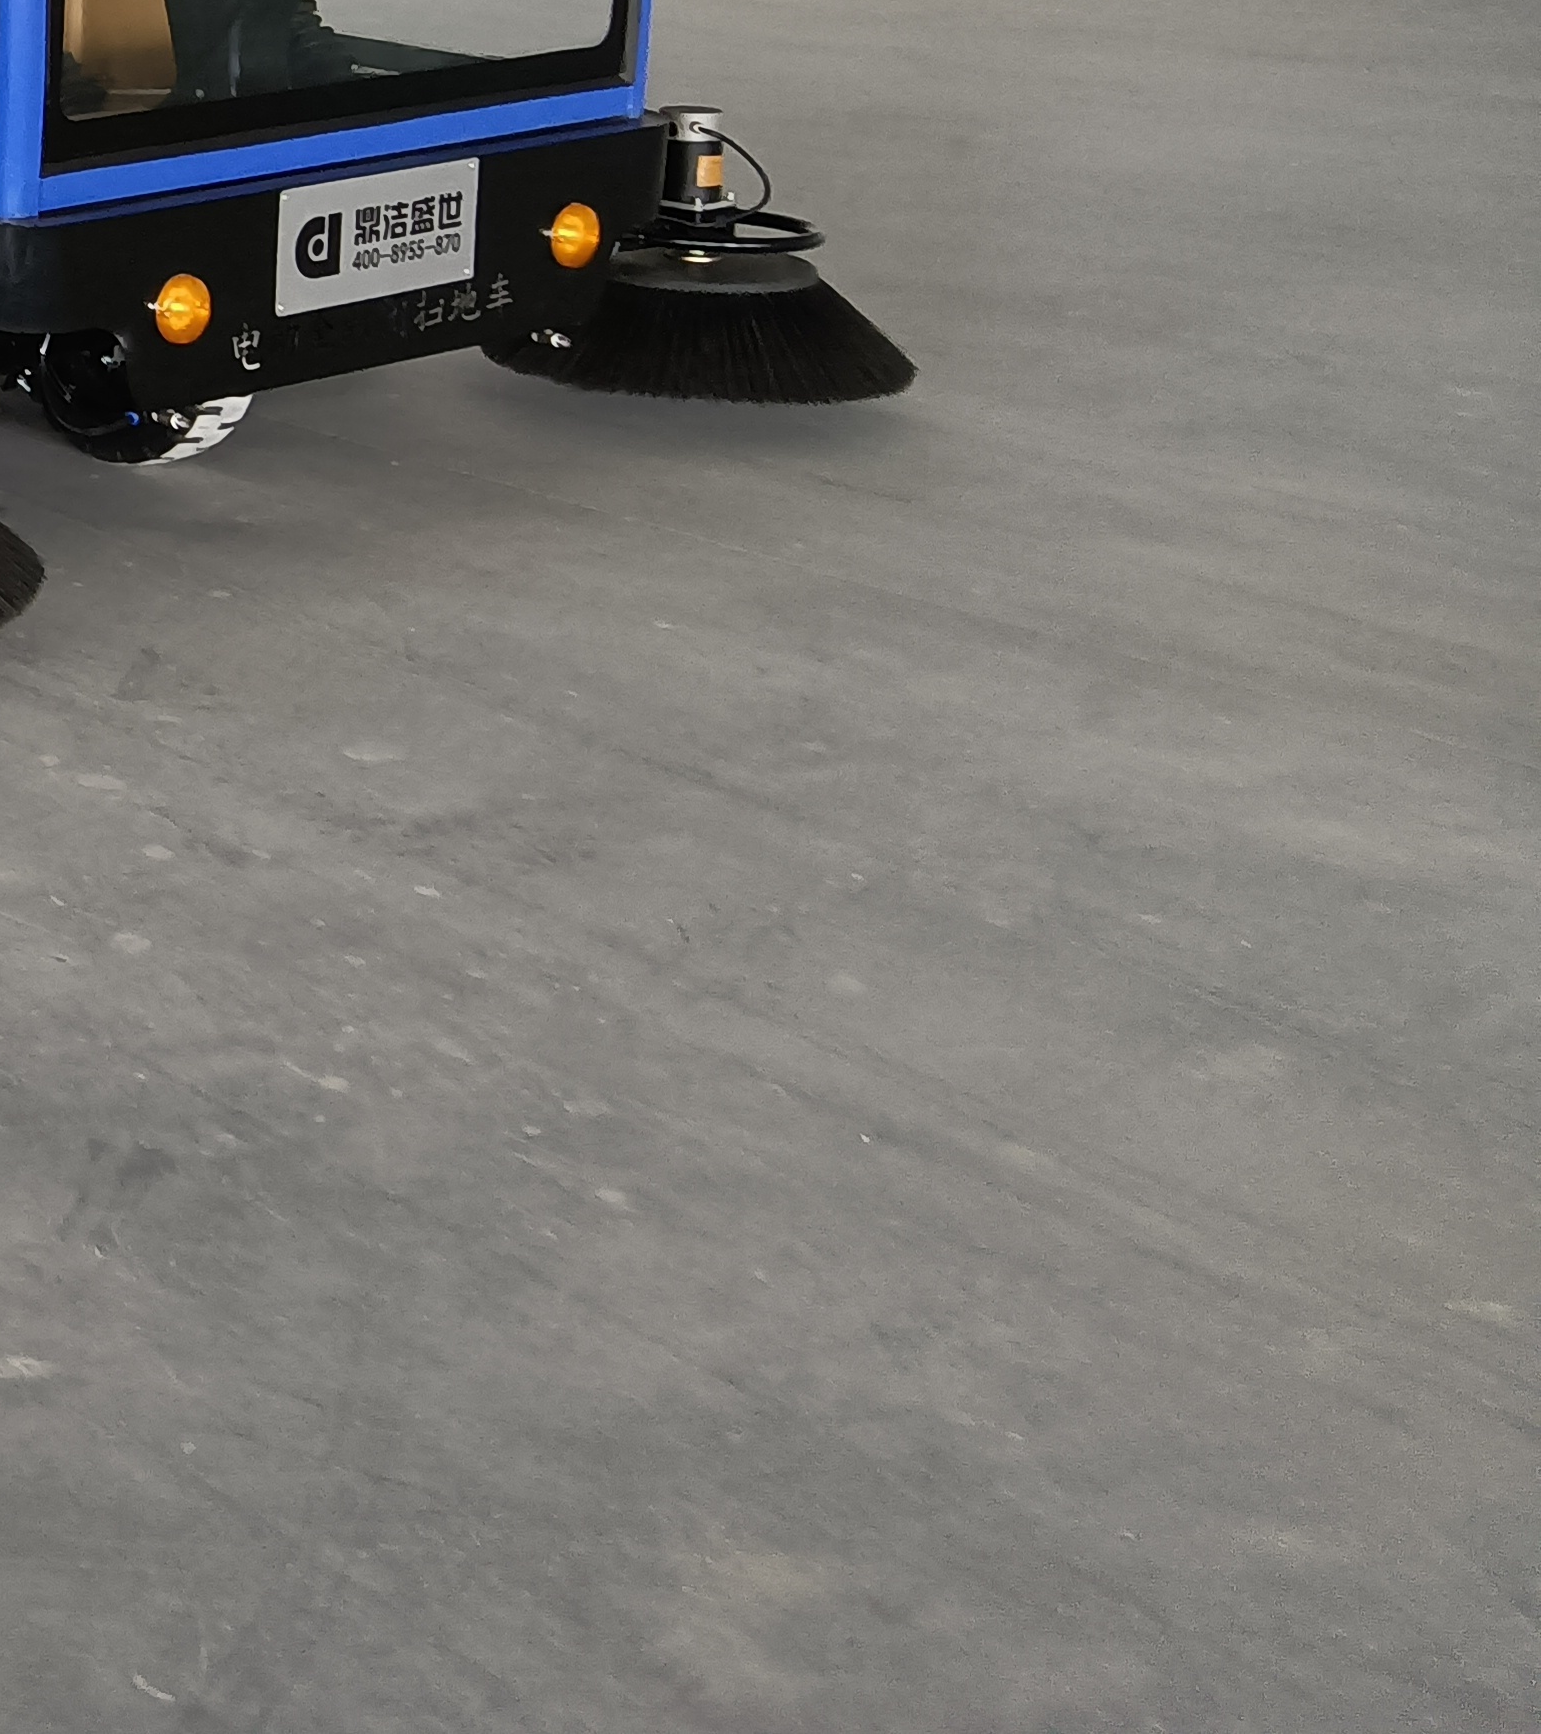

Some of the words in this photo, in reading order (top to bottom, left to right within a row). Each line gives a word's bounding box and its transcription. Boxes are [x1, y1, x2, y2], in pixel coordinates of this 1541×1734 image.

[354, 191, 463, 245] 鼎洁盛世
[352, 233, 461, 270] 400-8955-870
